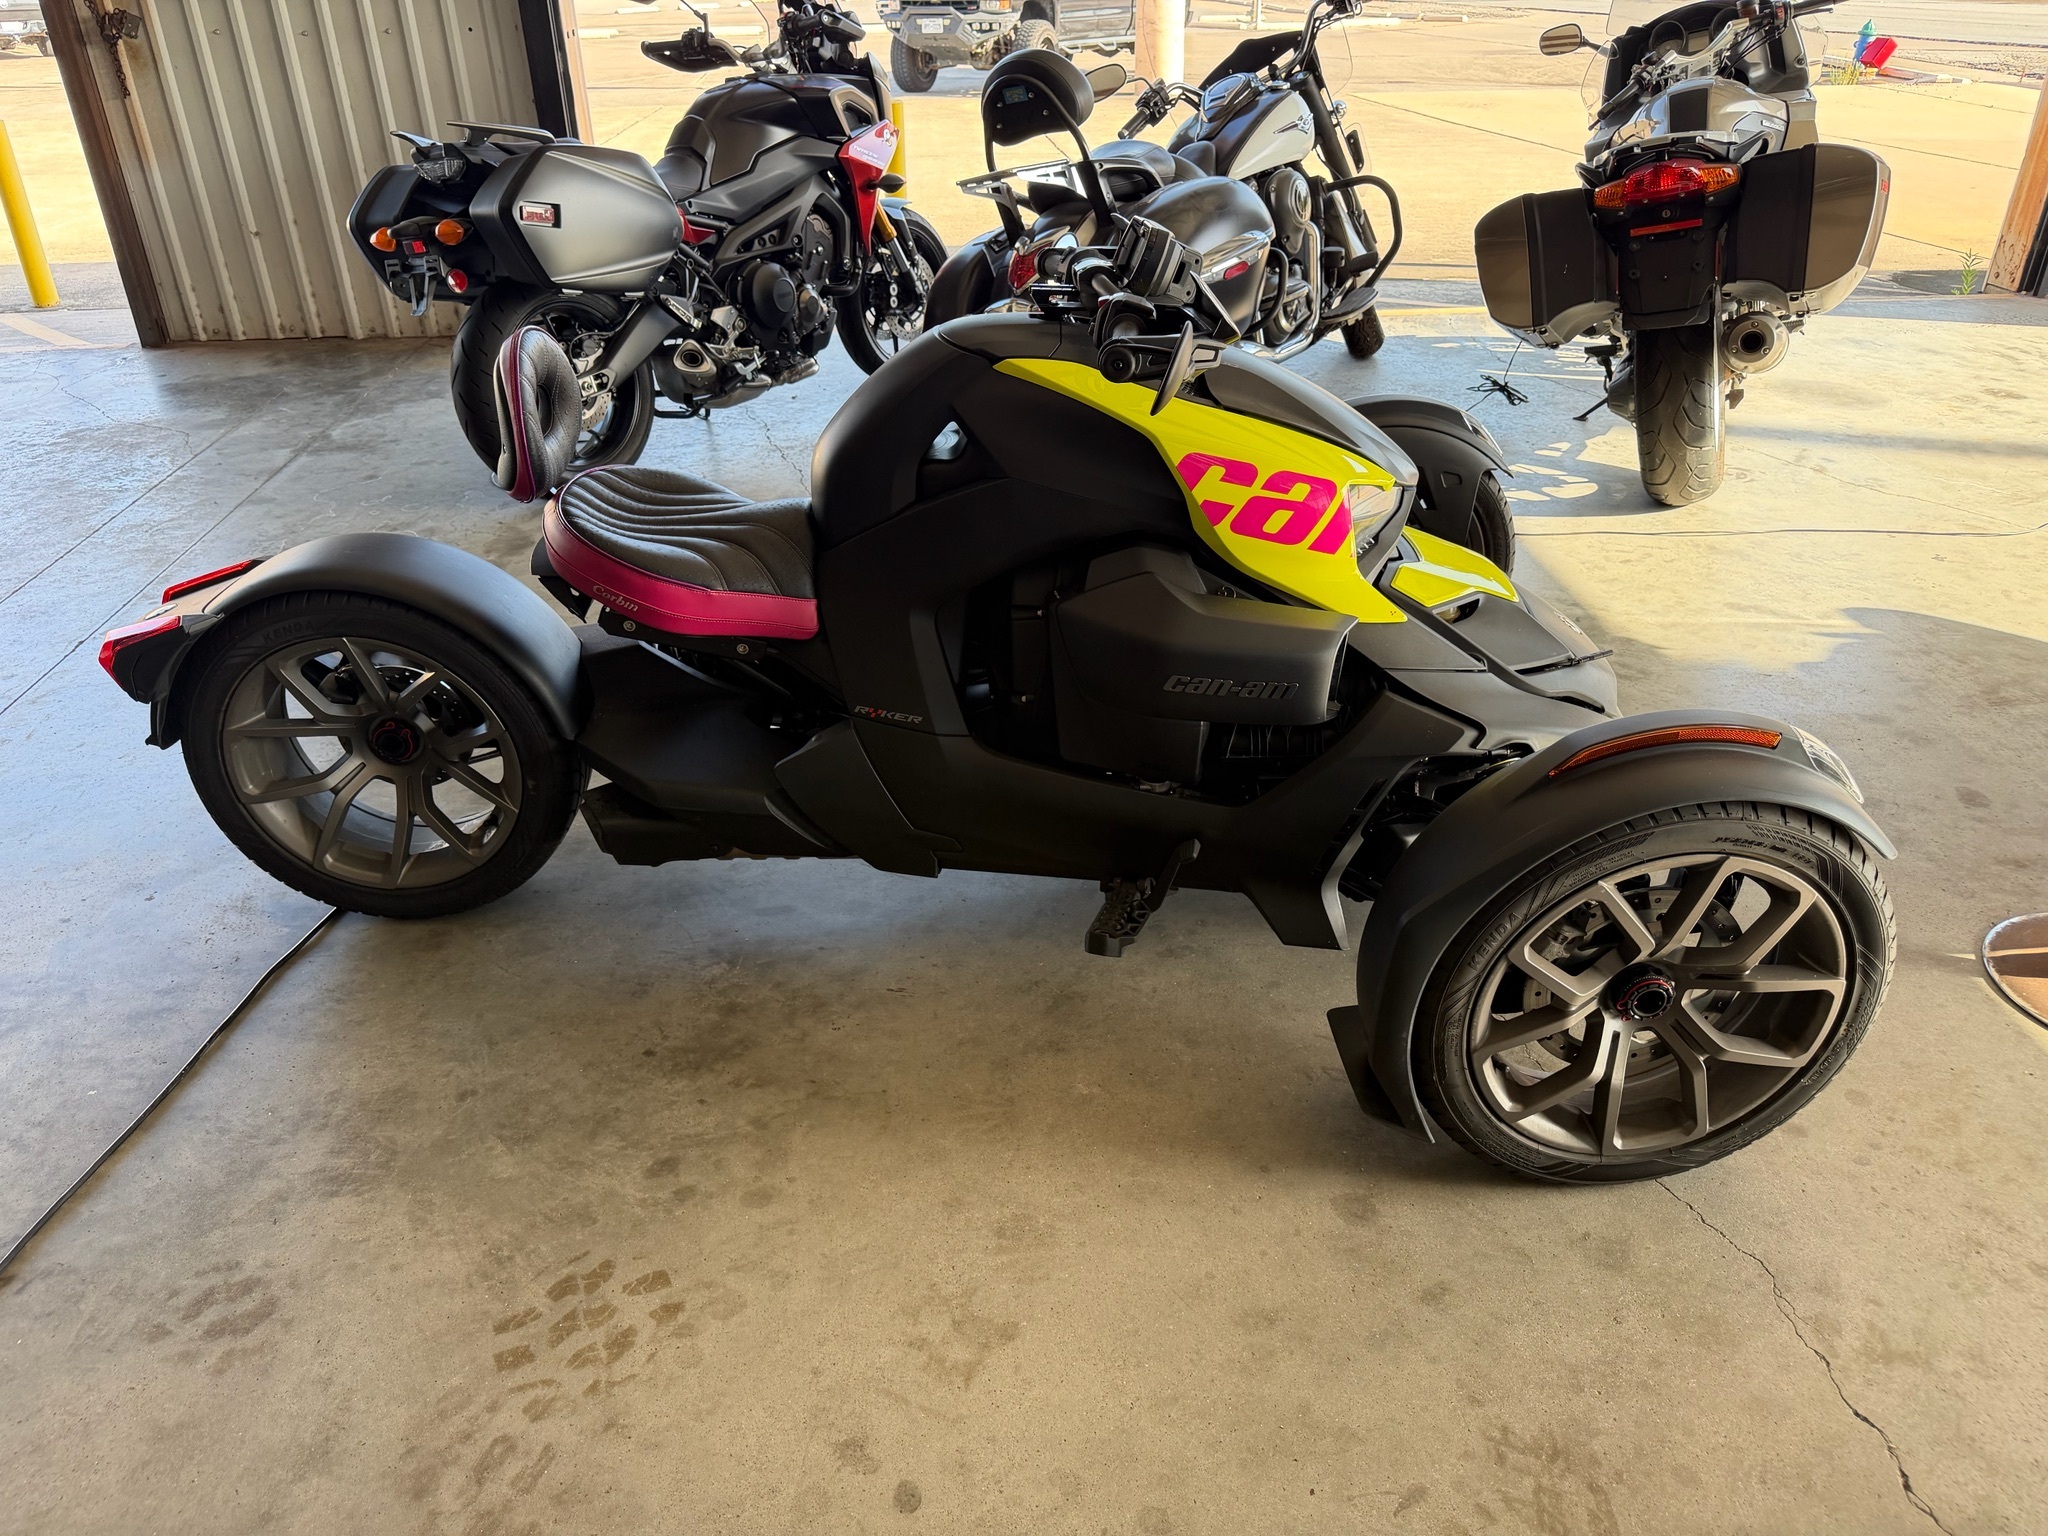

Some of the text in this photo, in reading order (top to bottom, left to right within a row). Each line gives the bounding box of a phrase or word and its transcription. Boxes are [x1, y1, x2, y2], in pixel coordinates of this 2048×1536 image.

[592, 585, 639, 612] Corbin
[854, 705, 923, 724] RYKER
[1467, 912, 1522, 971] KENDA
